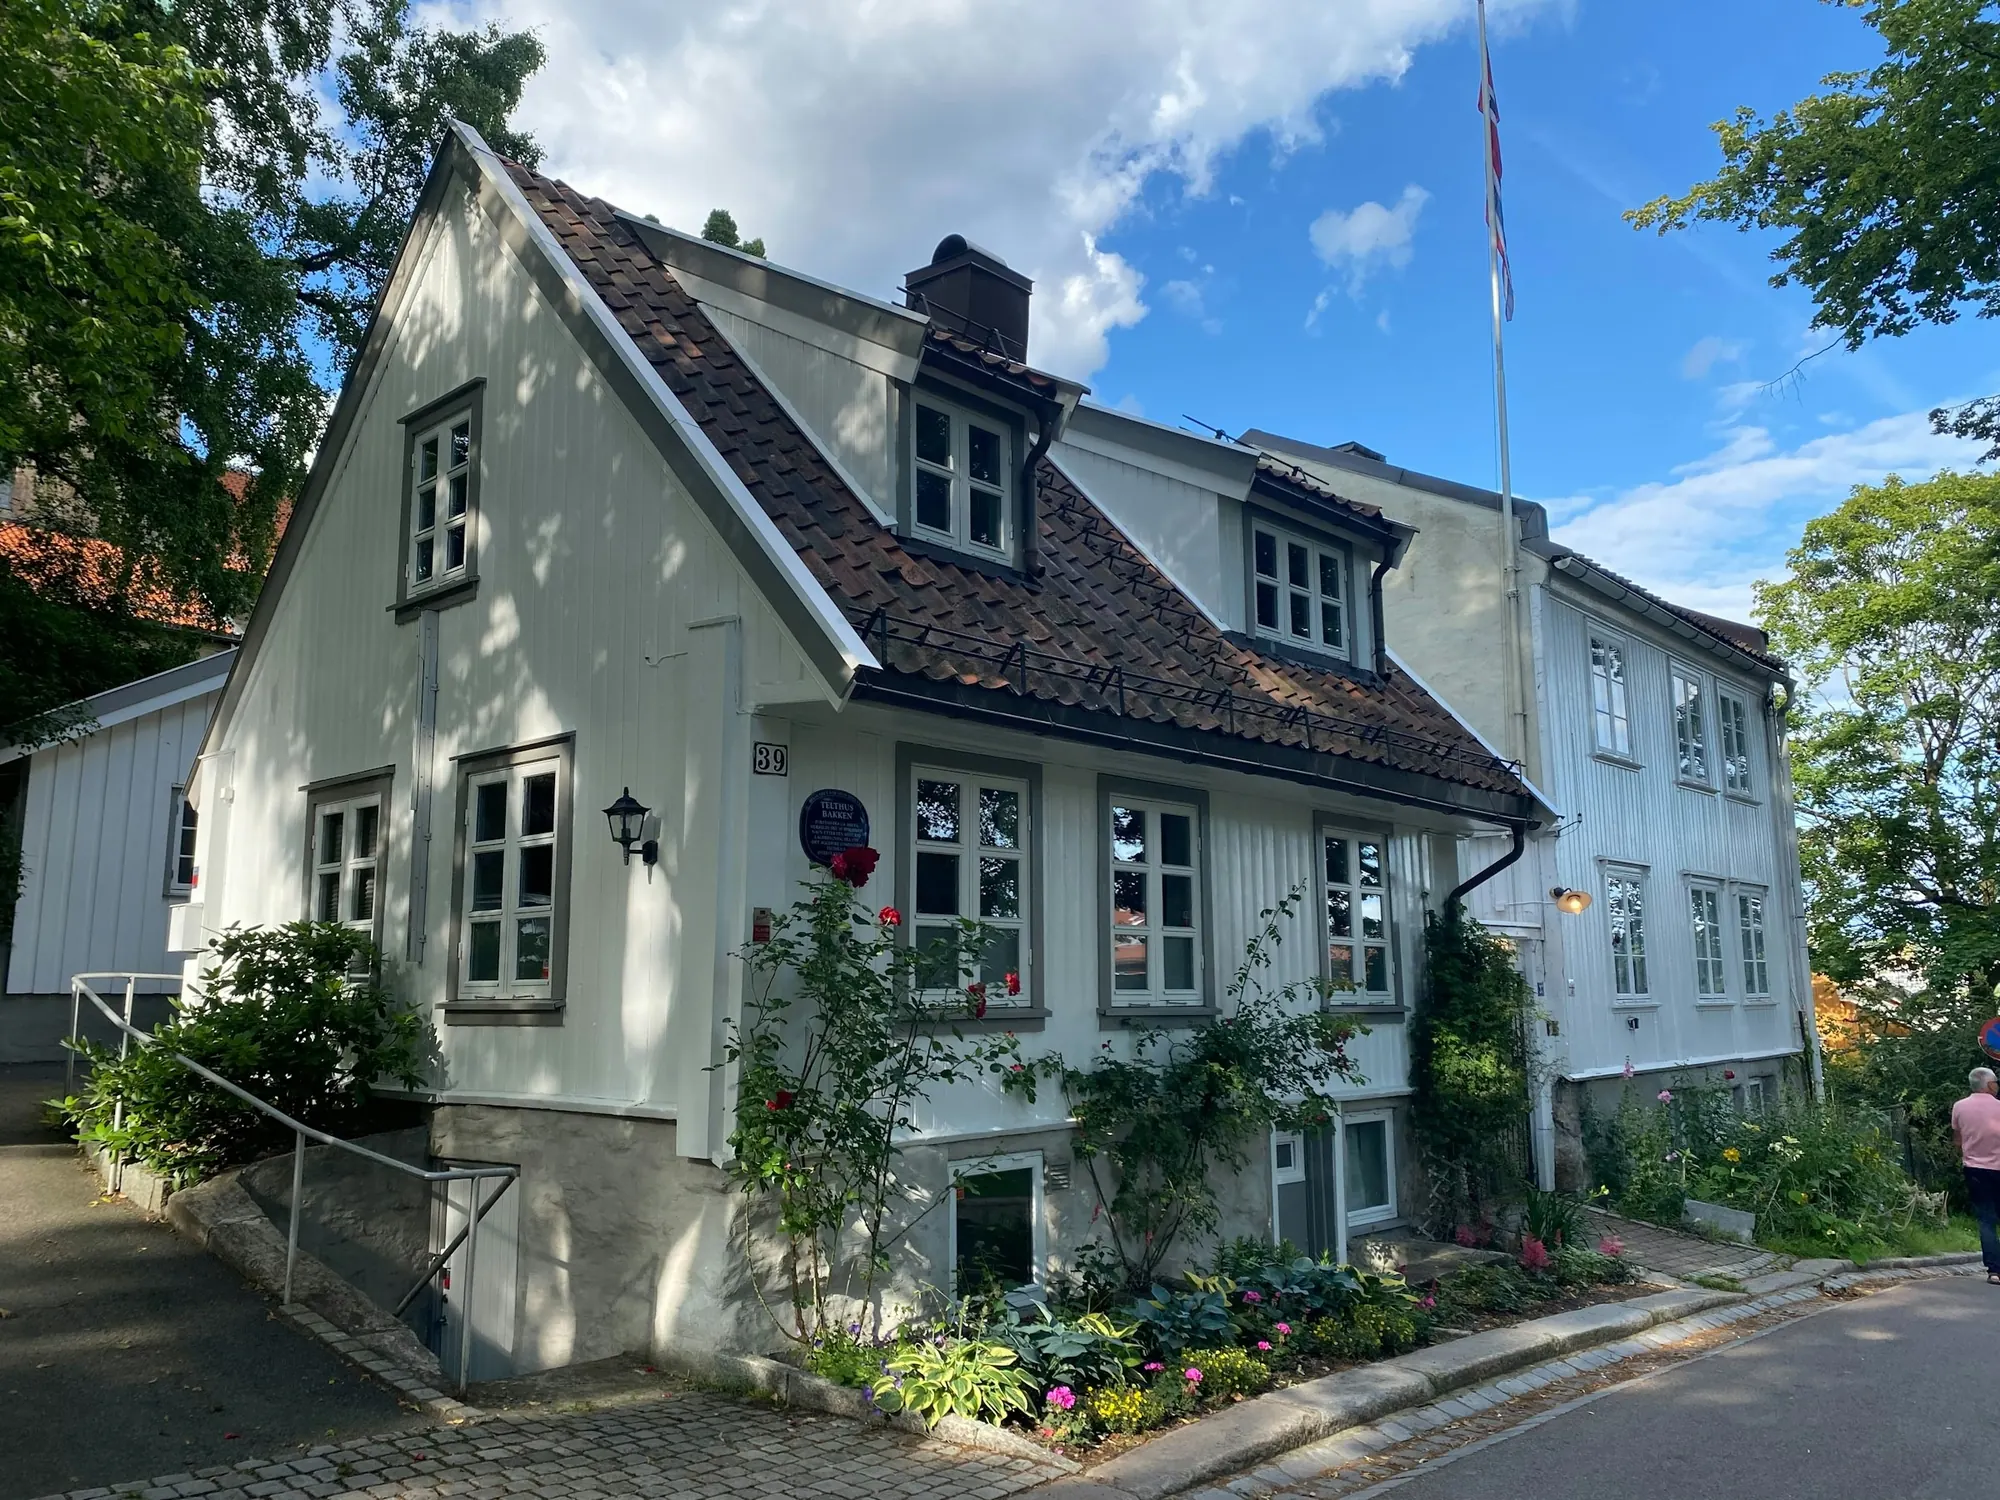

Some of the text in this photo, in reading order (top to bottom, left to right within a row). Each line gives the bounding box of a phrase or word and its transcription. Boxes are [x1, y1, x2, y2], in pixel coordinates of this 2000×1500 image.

[758, 747, 785, 772] 39
[821, 801, 854, 811] TELTHUS
[822, 810, 854, 820] BAKKEN
